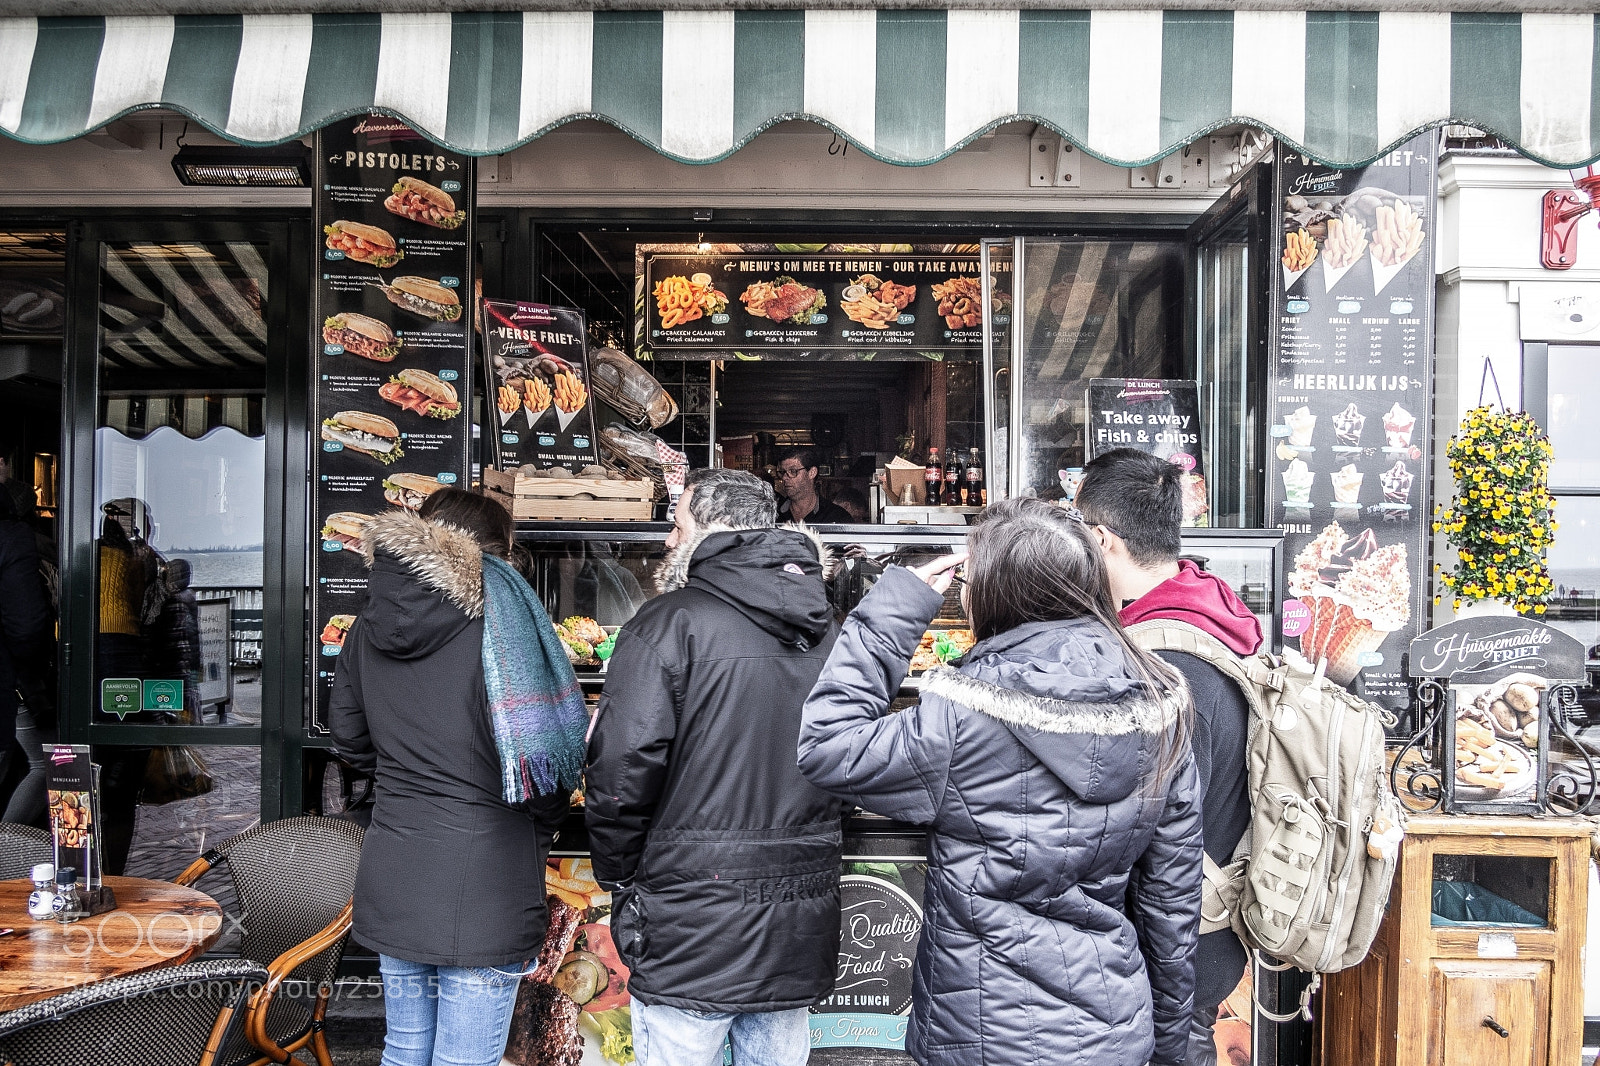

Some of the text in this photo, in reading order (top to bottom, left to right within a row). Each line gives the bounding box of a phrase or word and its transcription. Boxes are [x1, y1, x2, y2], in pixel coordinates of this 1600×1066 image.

[345, 151, 447, 172] PISTOLETS
[1313, 181, 1335, 191] FRIES
[740, 261, 780, 272] MENU'S
[783, 261, 800, 272] OM
[803, 262, 825, 272] MEE
[829, 261, 842, 272] TE
[845, 261, 882, 272] NEMEN
[893, 261, 915, 272] OUR
[918, 262, 946, 272] TAKE
[950, 262, 981, 273] AWAY
[990, 261, 1013, 273] MEN
[528, 306, 549, 314] LUNCH
[1362, 317, 1390, 325] MEDIUM
[498, 326, 574, 346] VERSE FRIET
[786, 336, 801, 344] chips
[1293, 374, 1409, 391] HEERLIJK IJS
[1101, 410, 1191, 429] Take away
[1097, 428, 1198, 447] Fish & chips
[325, 541, 341, 549] 6,00
[1283, 608, 1308, 619] ratis
[1283, 620, 1300, 632] dip
[325, 646, 340, 655] 5,00
[1420, 627, 1552, 673] Huisgemaakte
[1492, 645, 1541, 663] FRIET
[850, 913, 922, 949] Quality
[835, 950, 886, 982] Food
[837, 994, 851, 1006] DE
[854, 994, 890, 1007] LUNCH
[830, 1018, 880, 1042] Tapas
